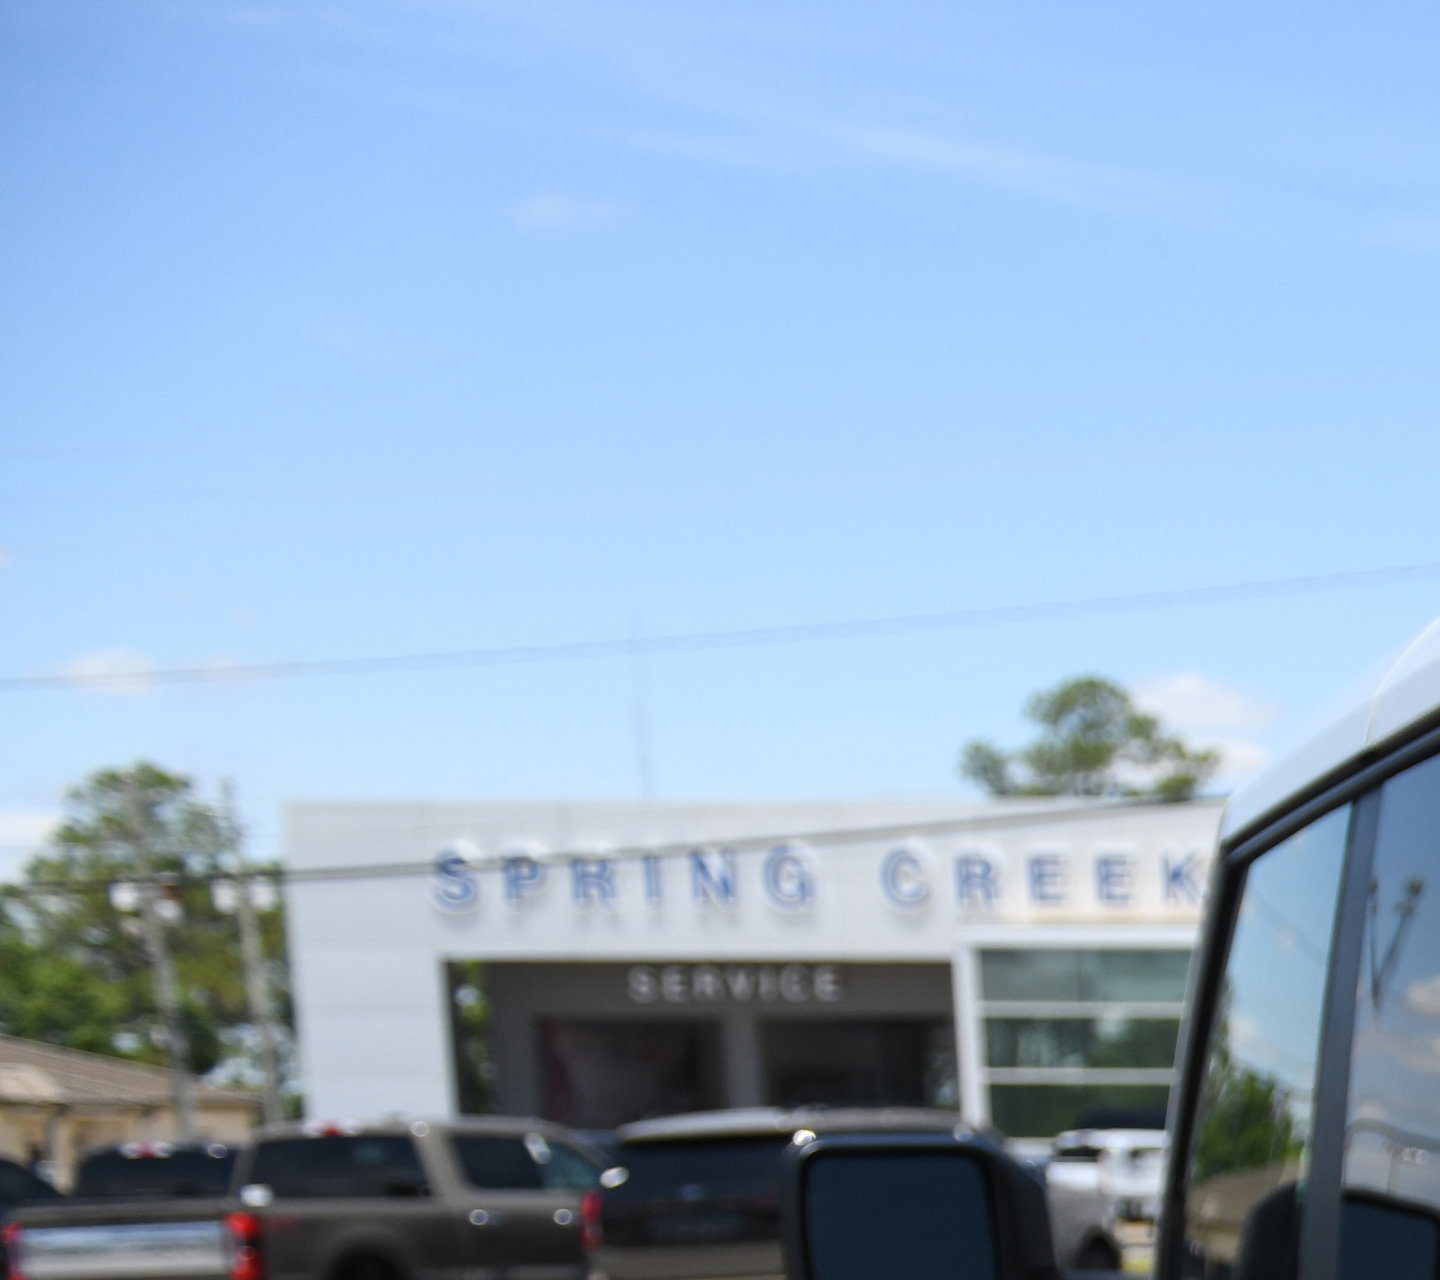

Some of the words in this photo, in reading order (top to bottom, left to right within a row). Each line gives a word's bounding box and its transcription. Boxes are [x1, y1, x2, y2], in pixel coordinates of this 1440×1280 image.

[433, 845, 818, 908] SPRING
[880, 848, 1207, 905] CREEK
[627, 965, 839, 1001] SERVICE
